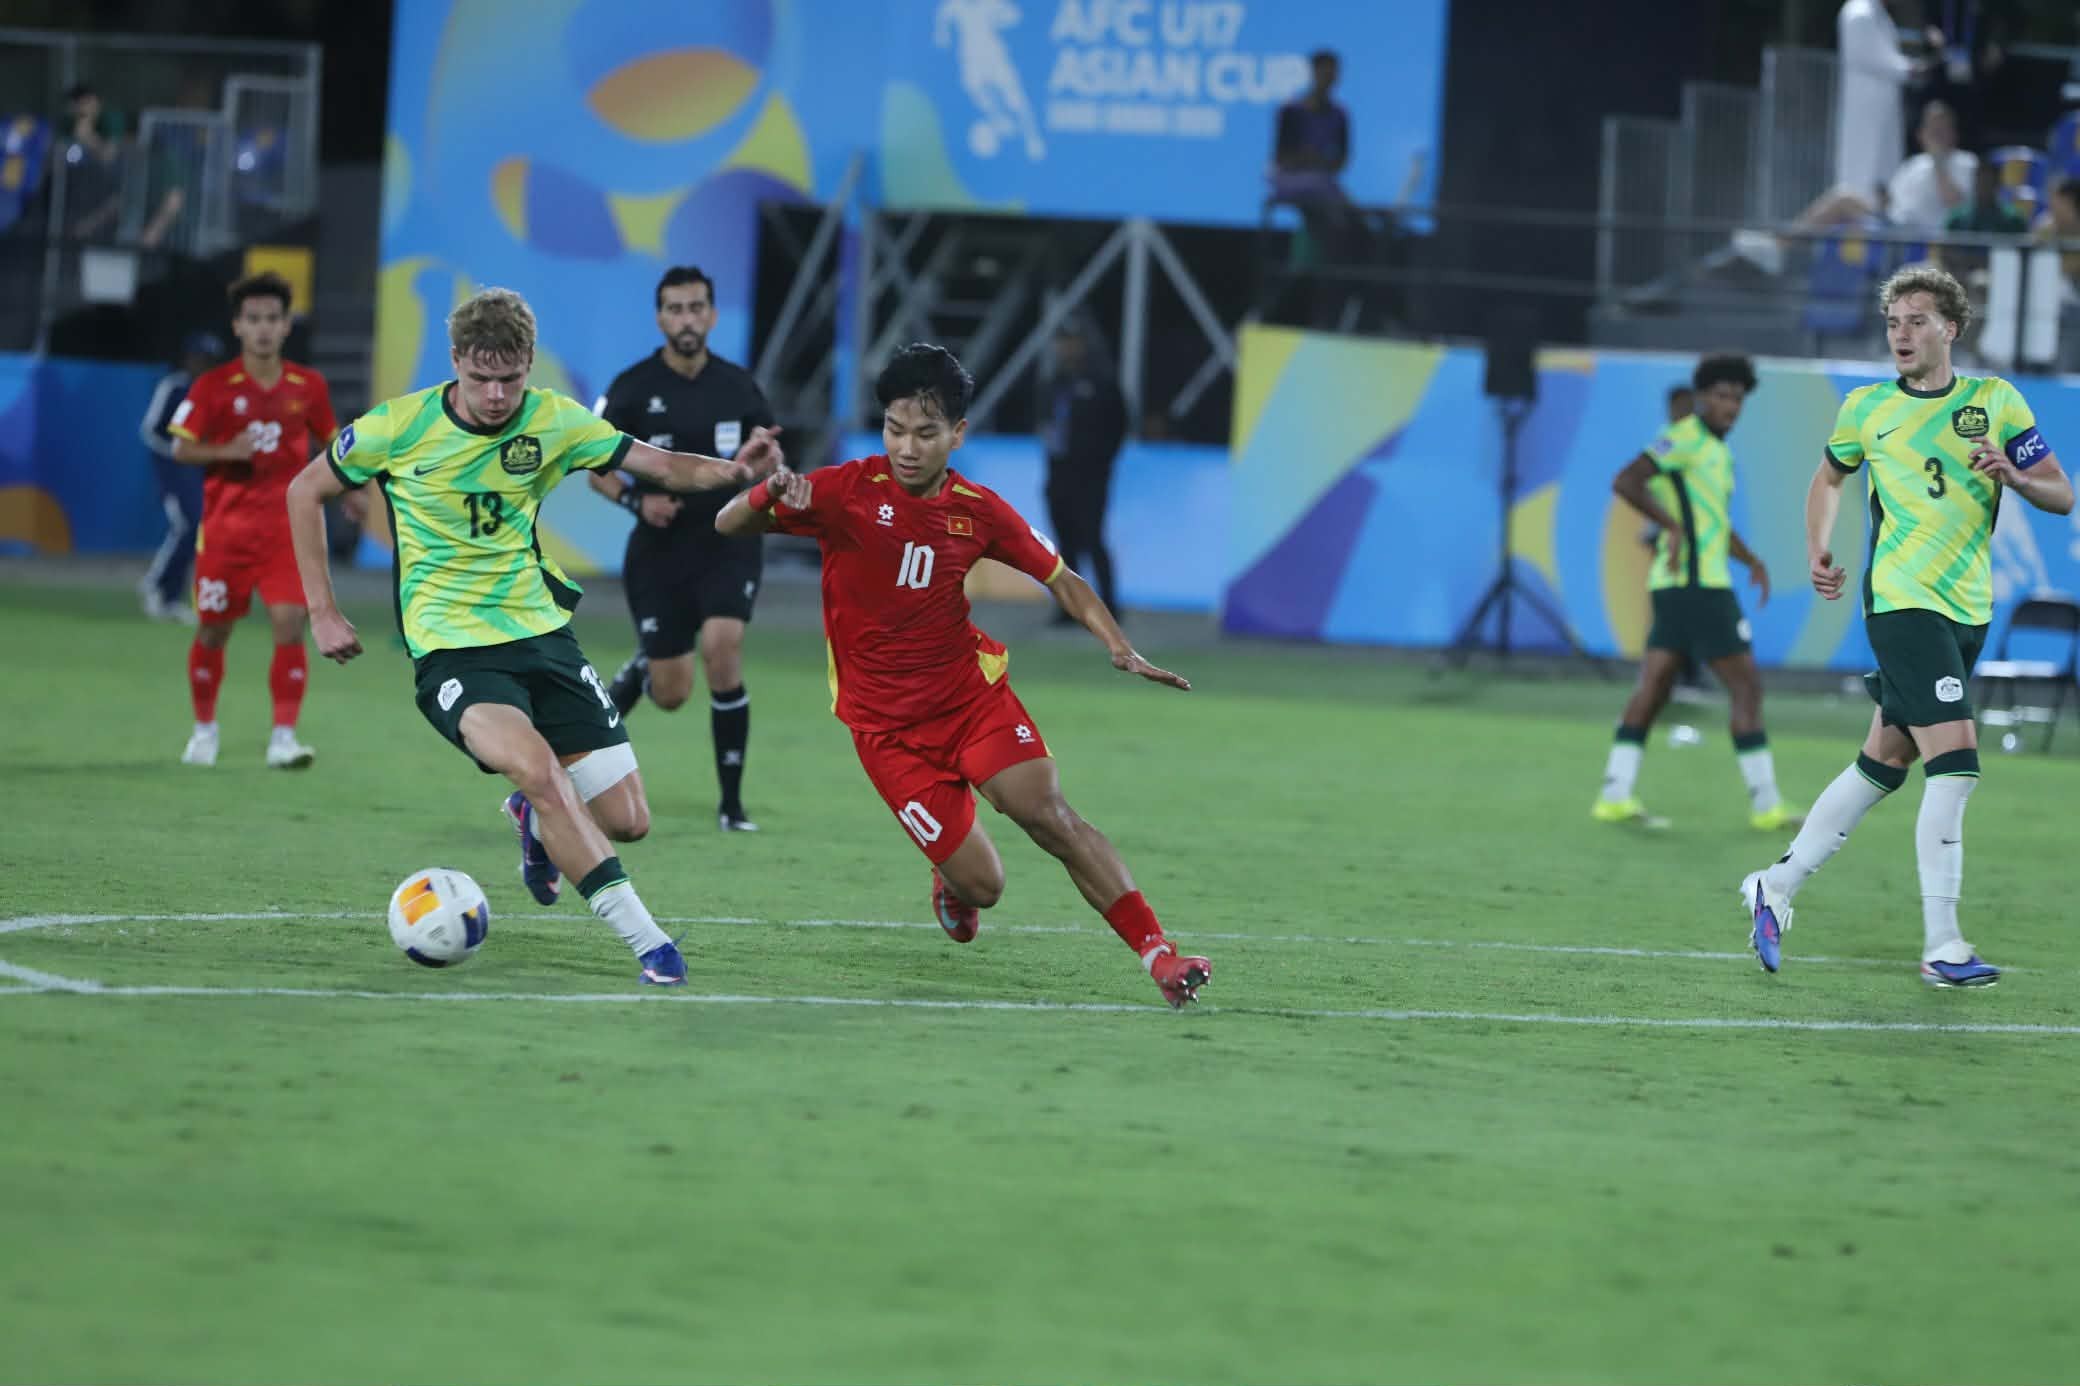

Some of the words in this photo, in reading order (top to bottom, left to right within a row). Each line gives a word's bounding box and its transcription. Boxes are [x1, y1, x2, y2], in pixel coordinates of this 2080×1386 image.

[1050, 0, 1153, 45] AFC
[1050, 50, 1198, 97] ASIAN
[2016, 434, 2044, 464] AFC
[1924, 457, 1945, 499] 3
[464, 491, 503, 538] 13
[896, 541, 935, 589] 10
[580, 665, 614, 709] 1
[898, 801, 943, 847] 10
